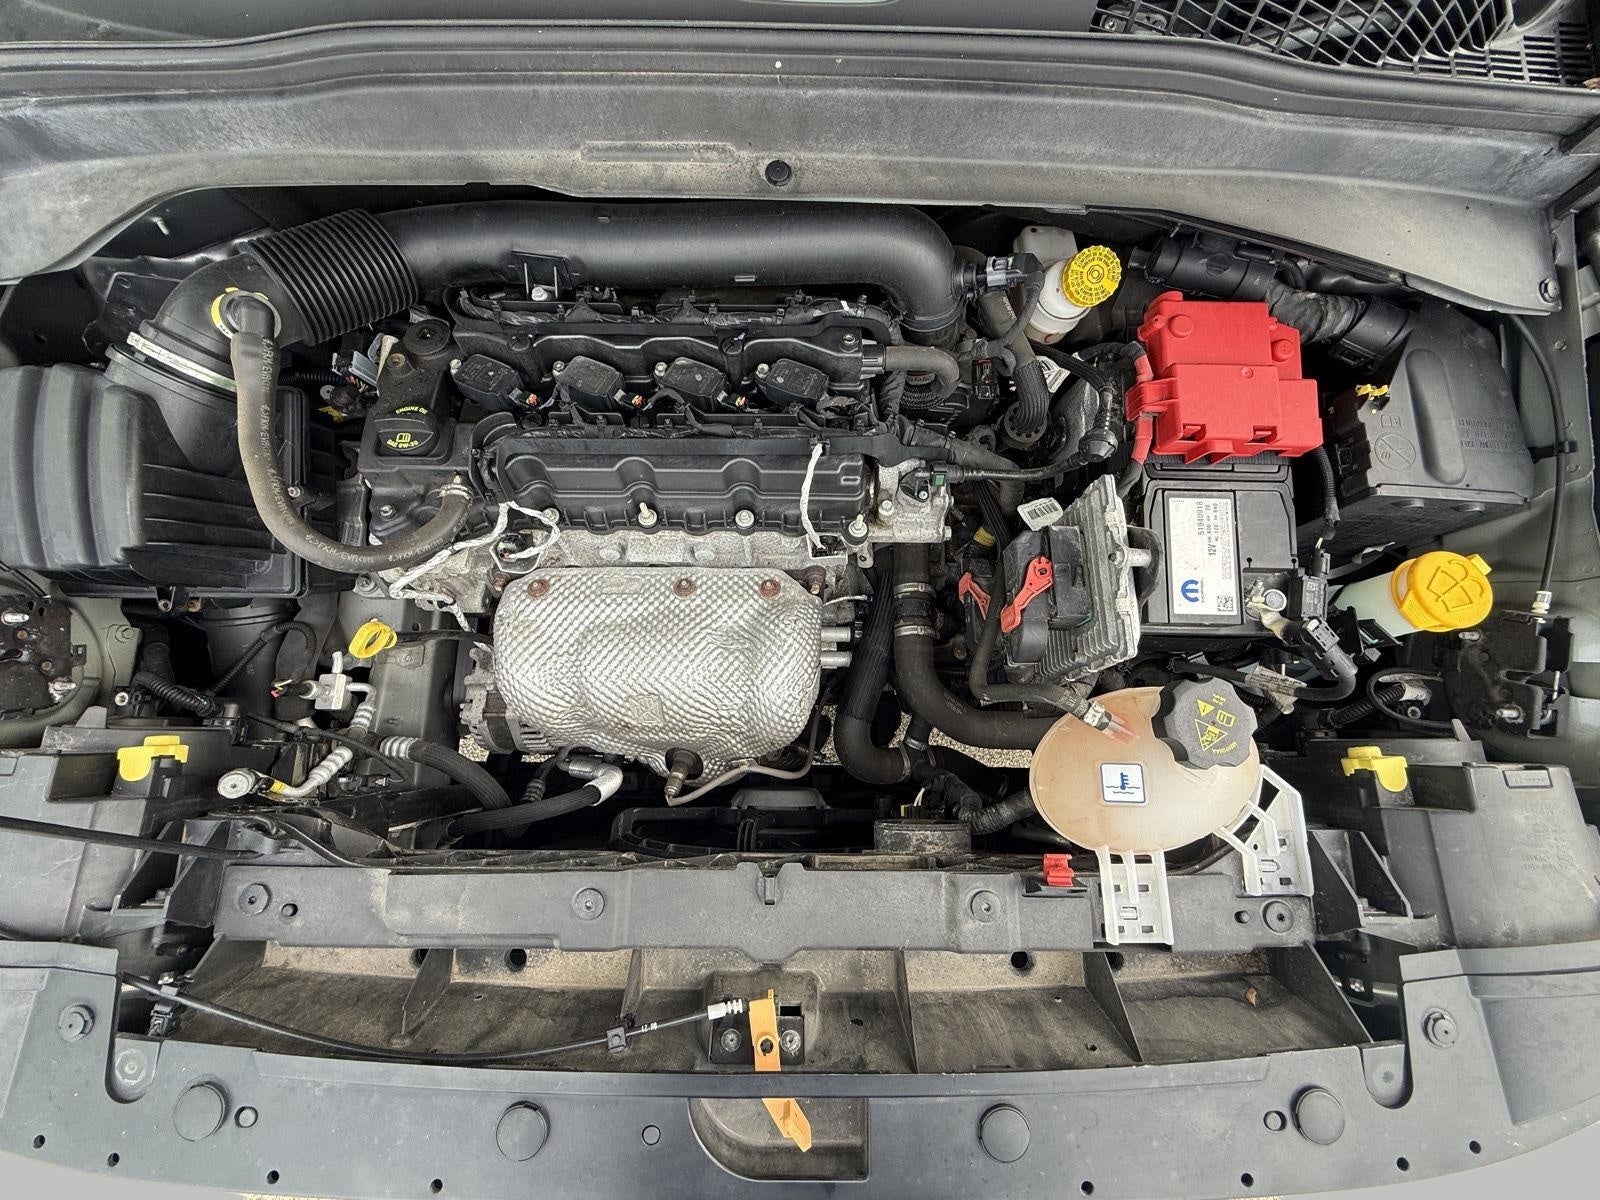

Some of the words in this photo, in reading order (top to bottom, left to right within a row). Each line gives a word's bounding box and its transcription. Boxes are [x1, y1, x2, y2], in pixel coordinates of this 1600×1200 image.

[396, 406, 419, 414] ENGINE
[419, 407, 428, 415] OIL
[387, 439, 398, 447] SAE
[1196, 501, 1204, 536] 51940918
[1208, 544, 1217, 556] 12V
